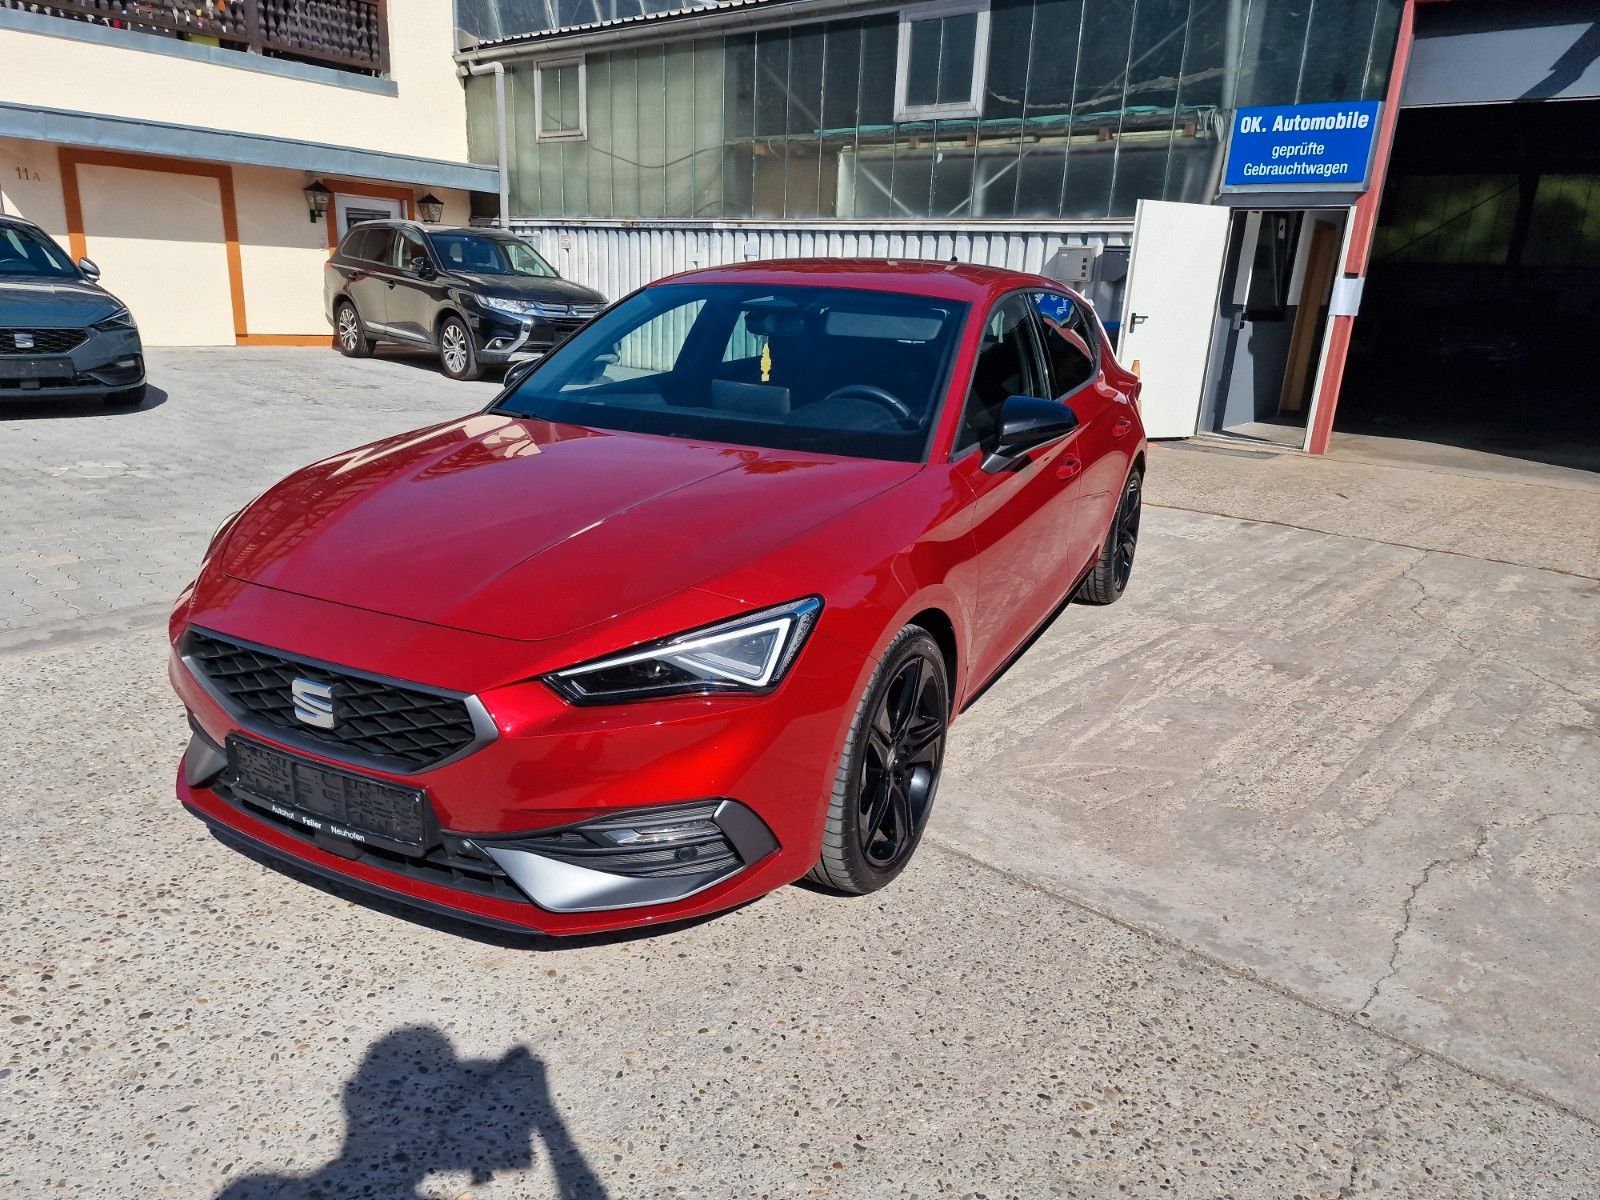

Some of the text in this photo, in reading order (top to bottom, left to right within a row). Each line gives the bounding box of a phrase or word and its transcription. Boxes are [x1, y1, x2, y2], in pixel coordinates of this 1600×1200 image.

[1240, 111, 1370, 133] OK. Automobile
[1272, 142, 1325, 159] geprüfte
[1243, 162, 1348, 177] Gebrauchtwagen
[302, 816, 322, 830] Feller
[330, 825, 365, 842] Neuhofen
